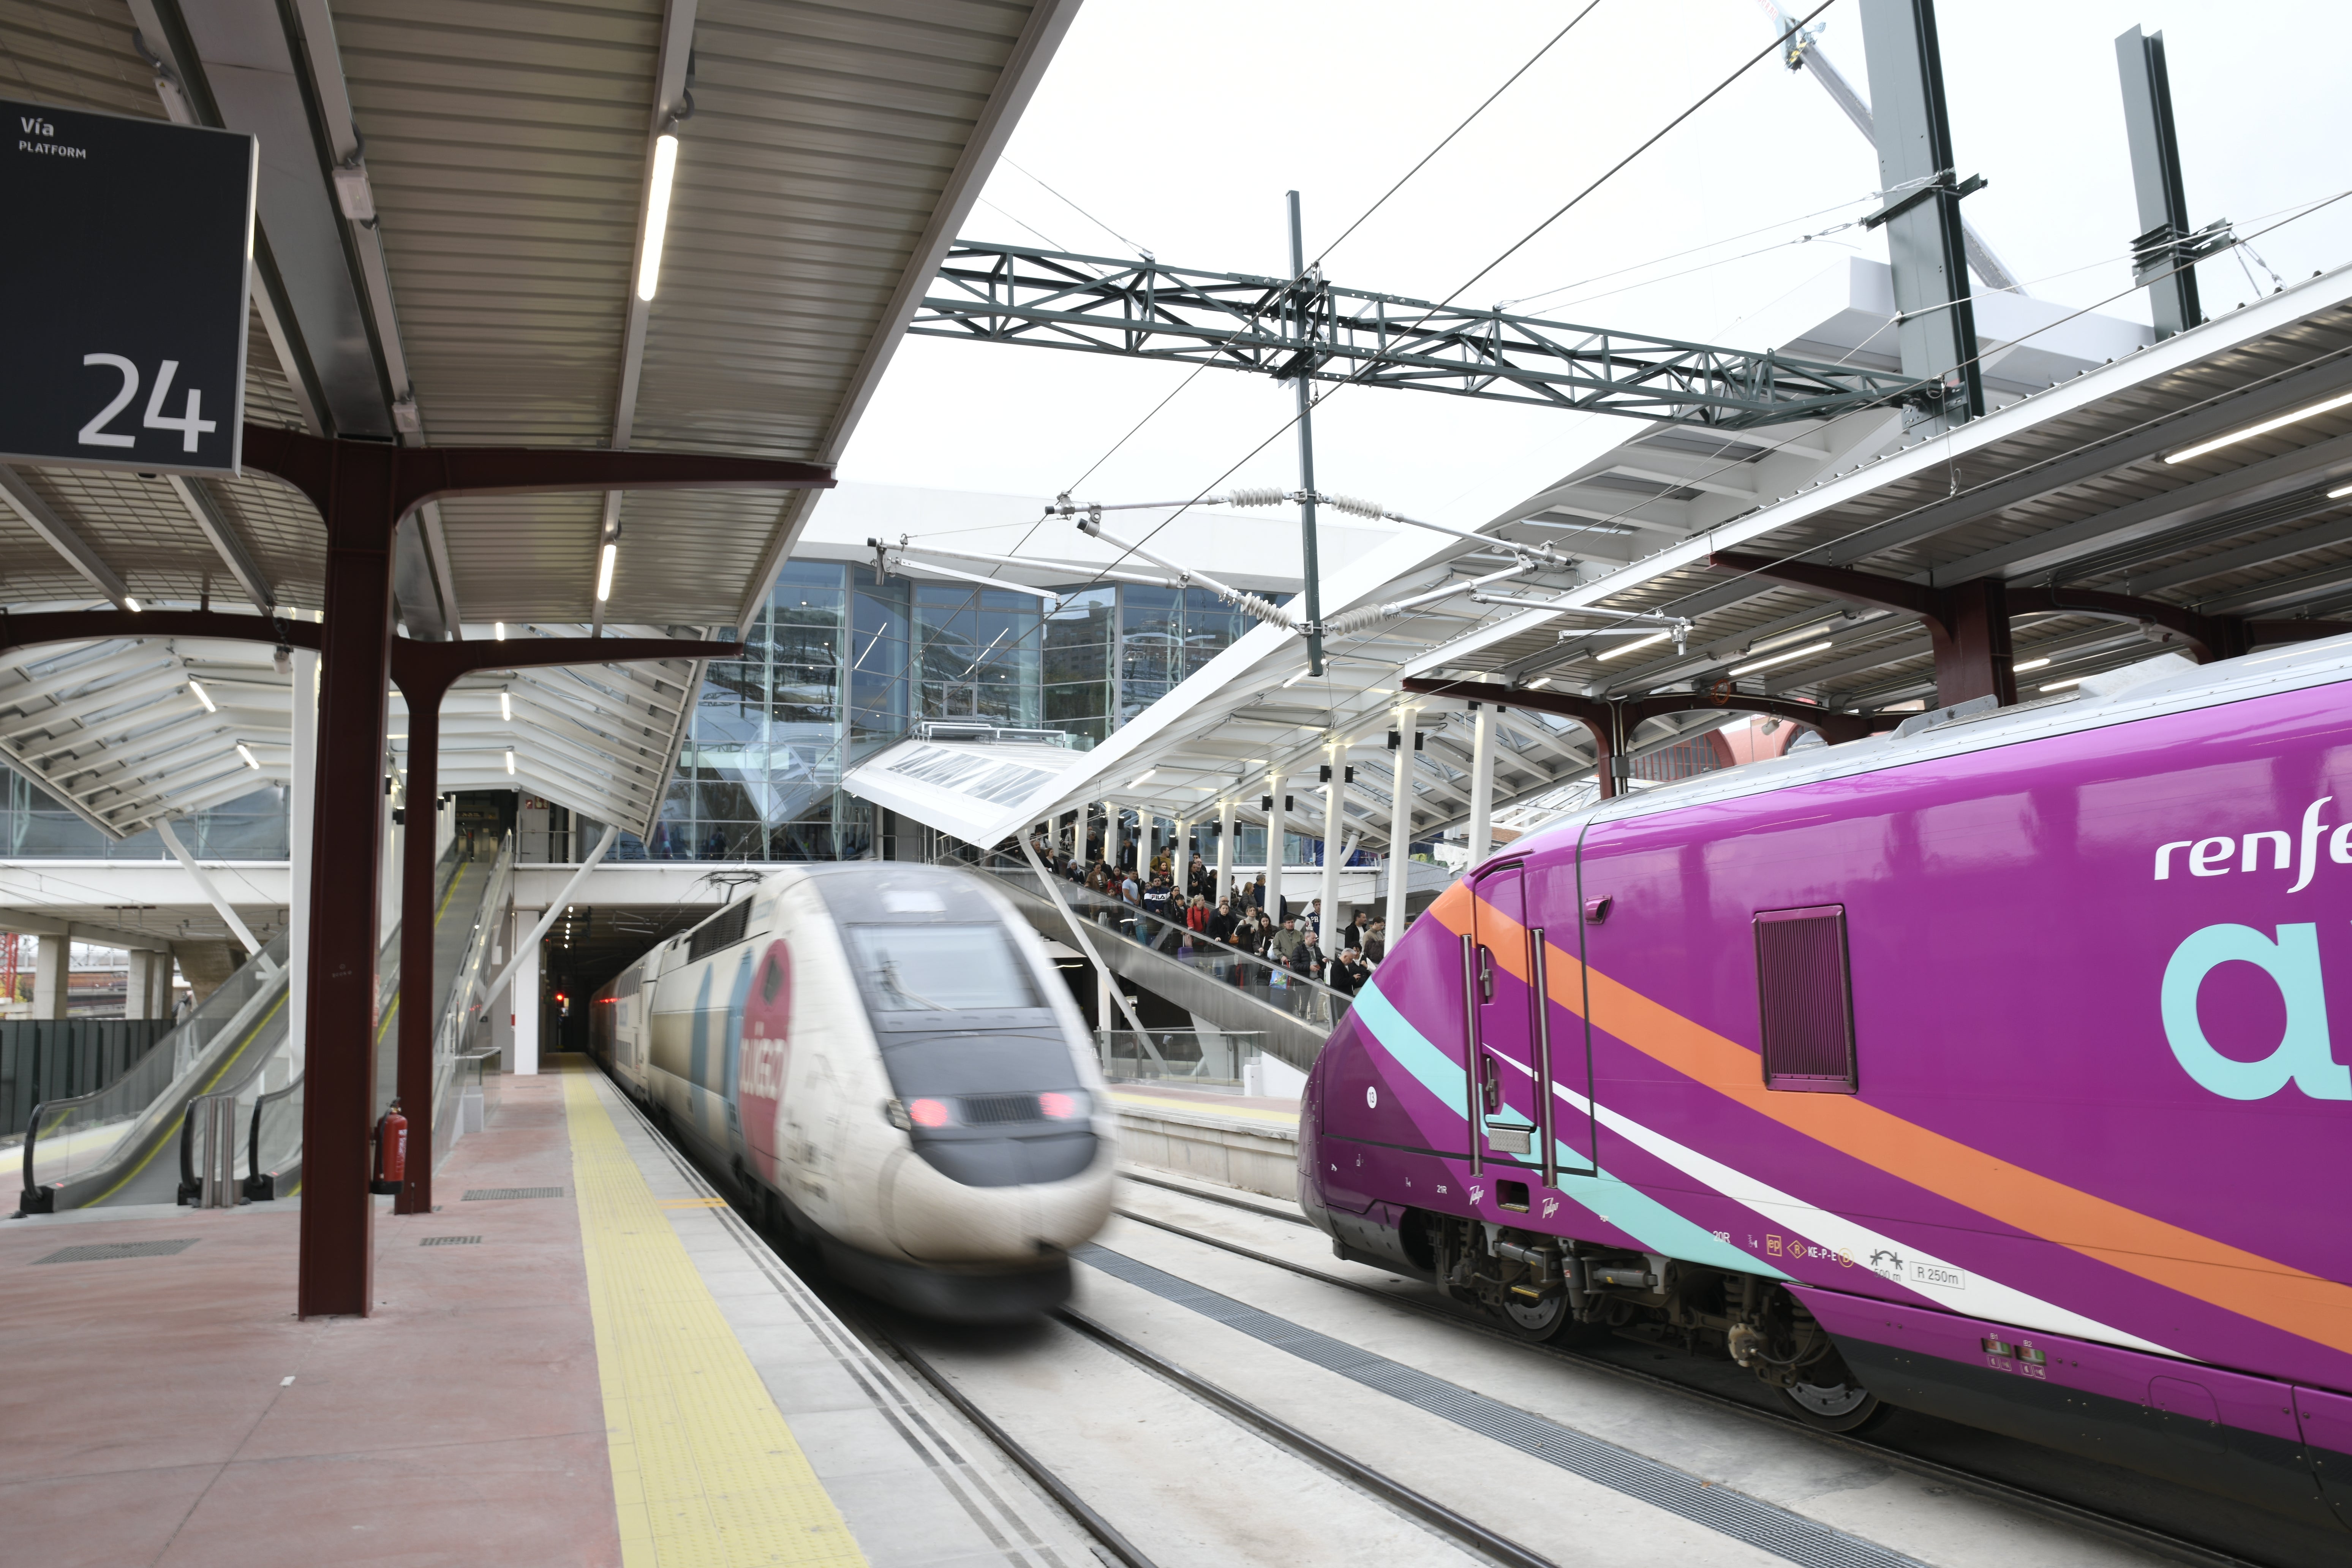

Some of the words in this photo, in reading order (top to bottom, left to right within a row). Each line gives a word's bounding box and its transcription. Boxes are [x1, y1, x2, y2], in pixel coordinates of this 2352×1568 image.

[21, 117, 54, 137] Vía
[19, 140, 86, 159] PLATFORM
[78, 353, 217, 453] 24
[2161, 920, 2352, 1101] a
[1369, 1092, 1375, 1103] 13
[1469, 1185, 1484, 1205] Talgo
[1542, 1197, 1559, 1219] Talgo
[1713, 1231, 1731, 1244] 20R
[1768, 1239, 1781, 1252] ep
[1794, 1244, 1800, 1254] R
[1807, 1246, 1837, 1261] KE-P-E
[1917, 1266, 1925, 1279] R
[1928, 1268, 1958, 1284] 250m
